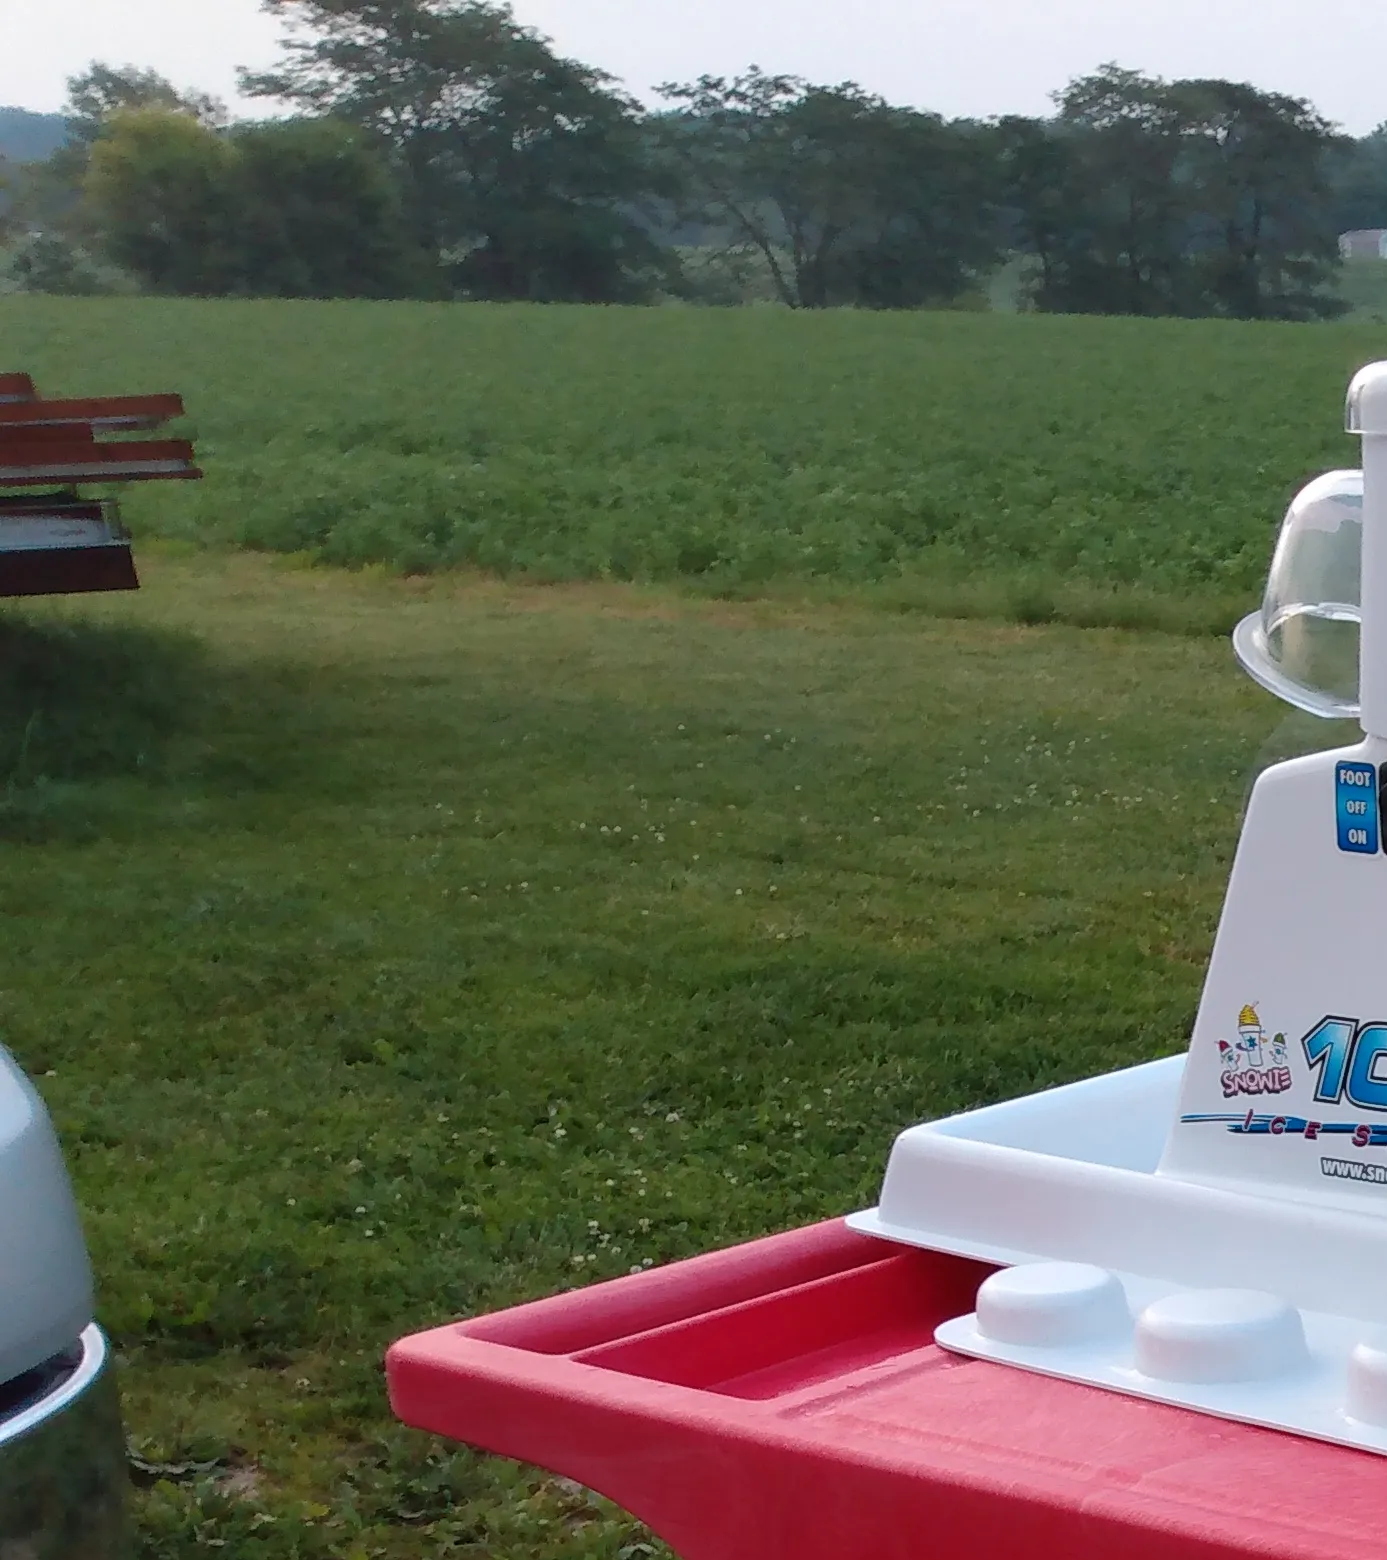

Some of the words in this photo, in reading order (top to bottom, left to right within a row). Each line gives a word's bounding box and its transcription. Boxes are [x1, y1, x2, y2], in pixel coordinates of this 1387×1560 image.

[1340, 769, 1371, 787] FOOT
[1346, 800, 1367, 815] OFF
[1348, 828, 1367, 845] ON
[1220, 1066, 1292, 1098] SNOWIE
[1242, 1108, 1322, 1141] ICE
